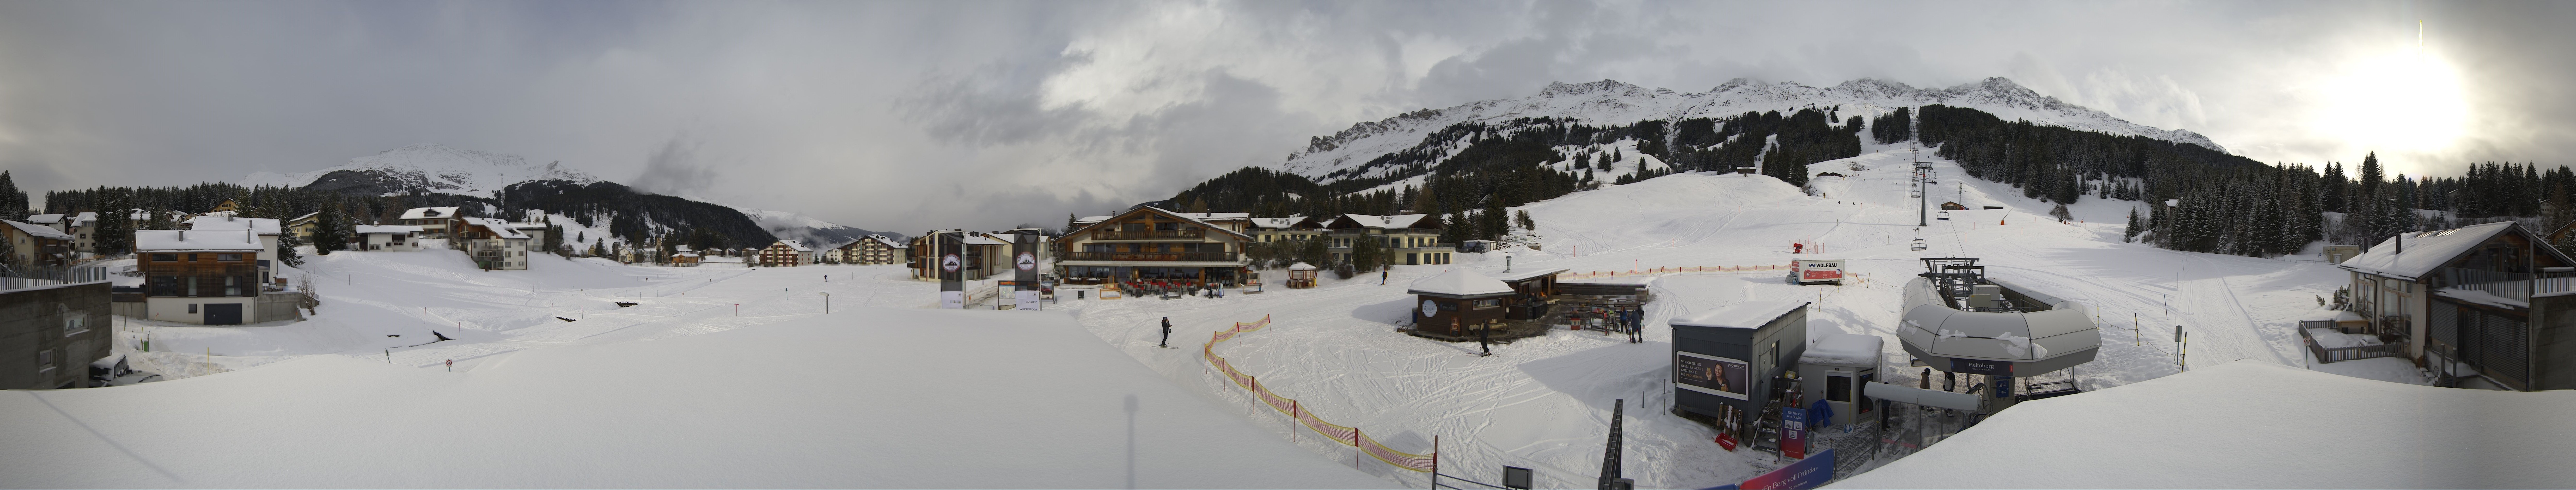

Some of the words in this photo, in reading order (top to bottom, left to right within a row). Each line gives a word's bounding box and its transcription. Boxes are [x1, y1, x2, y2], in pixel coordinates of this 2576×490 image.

[1773, 479, 1786, 489] Berg
[1787, 474, 1797, 482] voll
[1798, 466, 1818, 478] Fründa»
